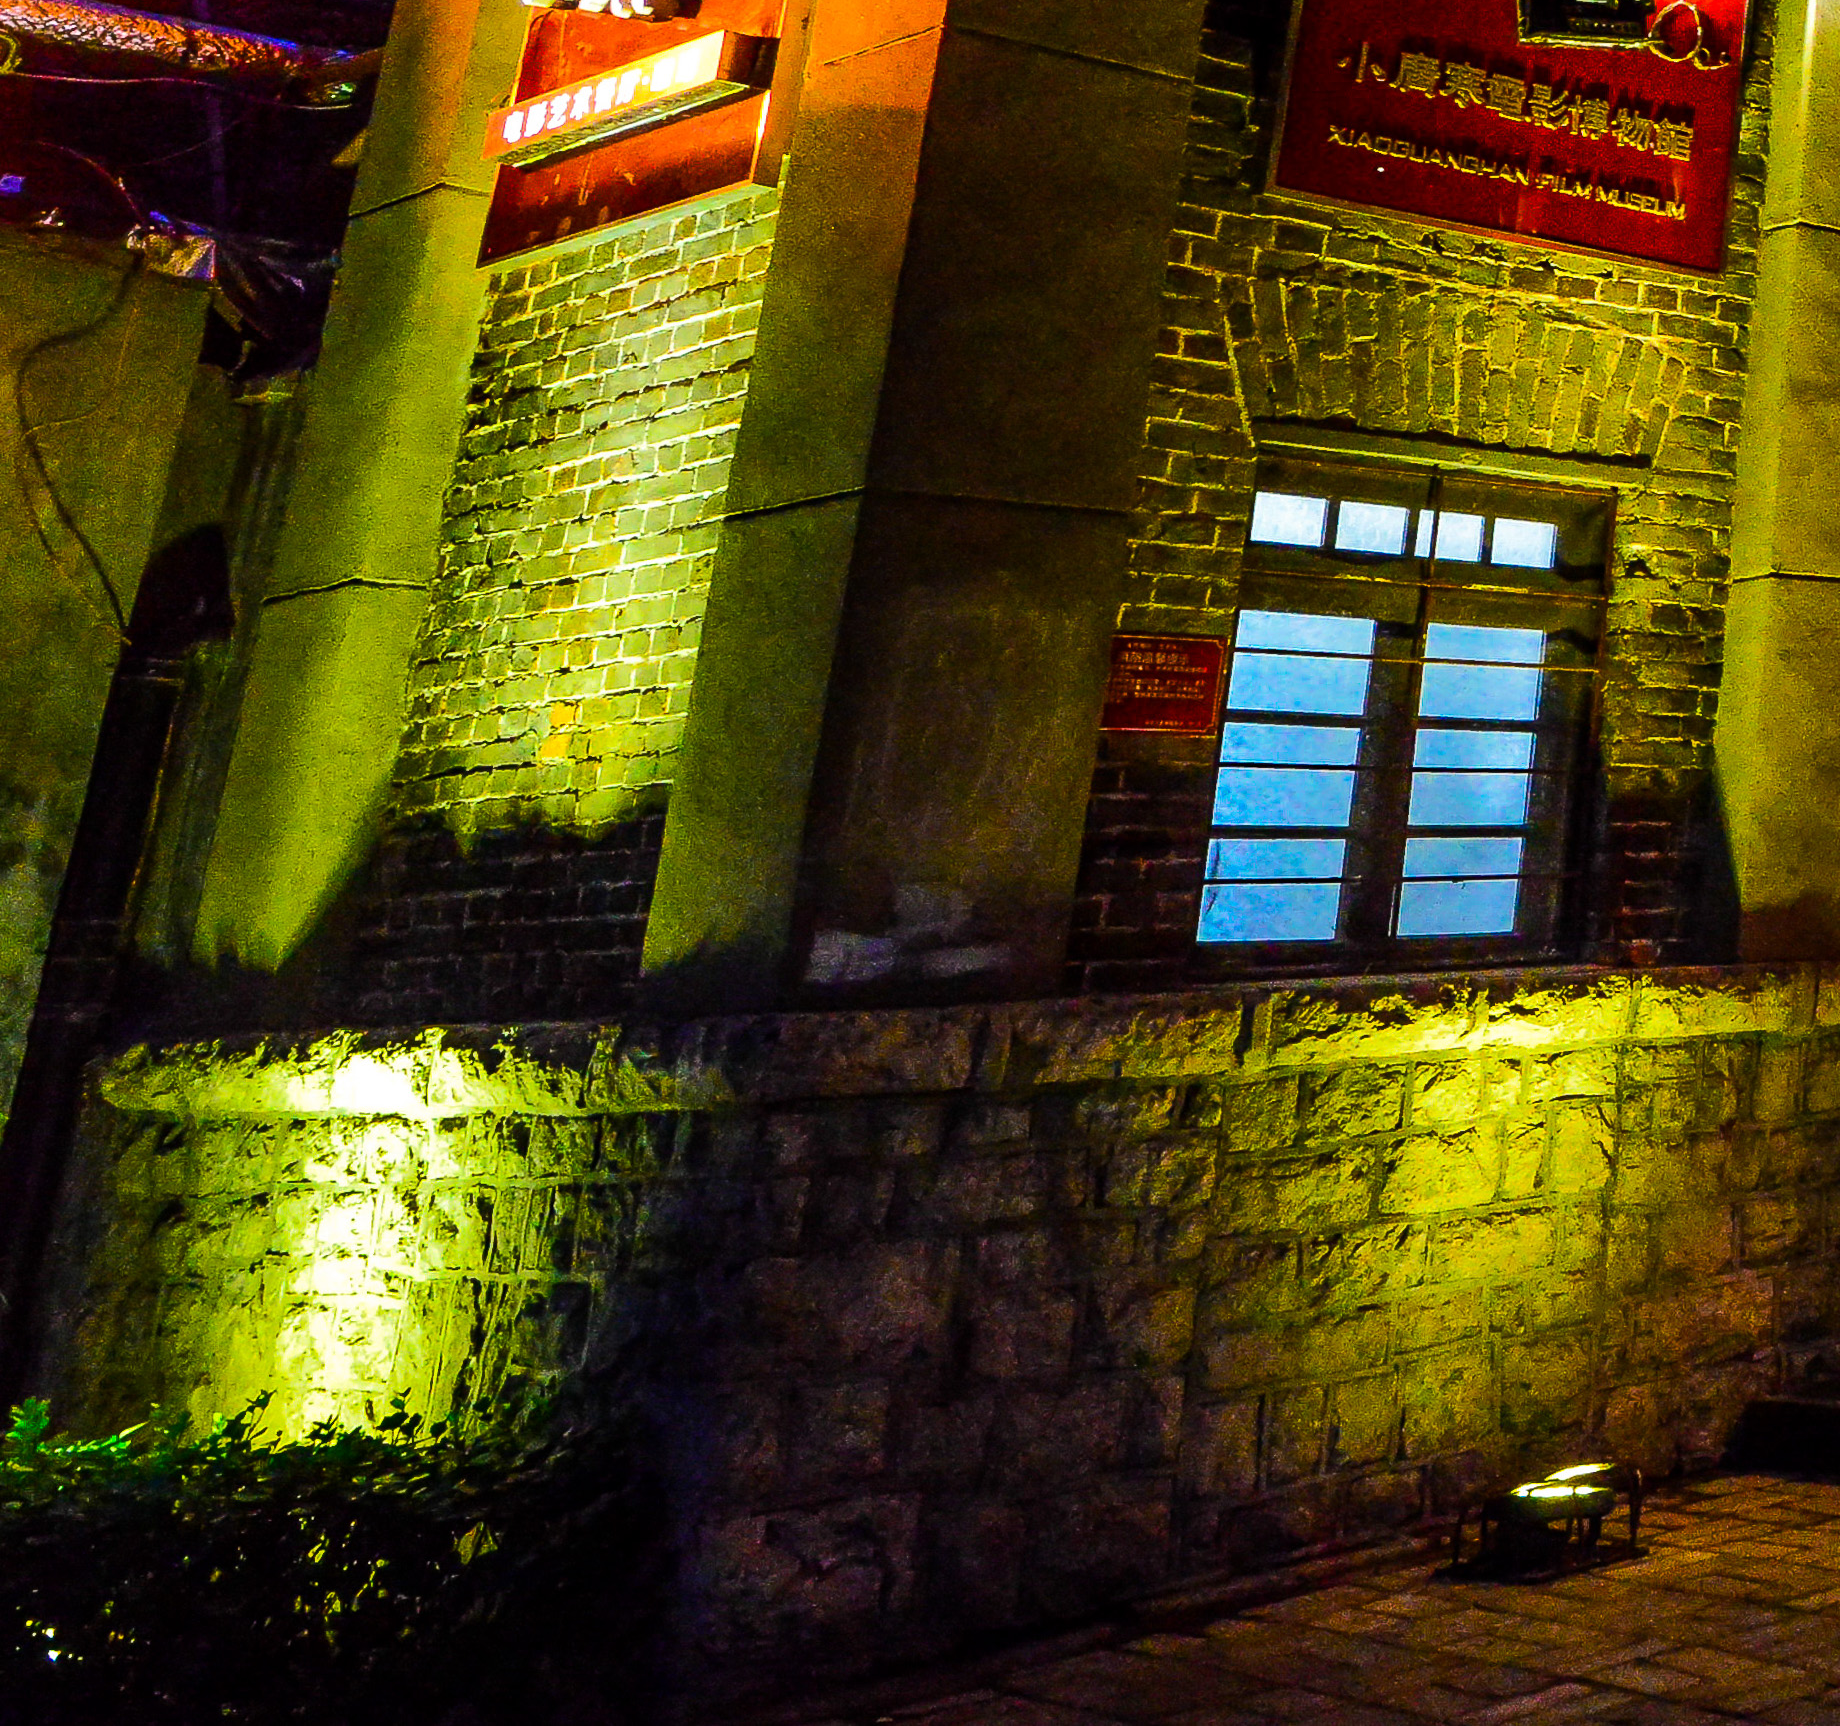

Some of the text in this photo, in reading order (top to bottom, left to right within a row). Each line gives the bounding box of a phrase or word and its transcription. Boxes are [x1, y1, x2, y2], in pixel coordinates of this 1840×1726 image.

[1327, 124, 1686, 221] XIAOGUANGHAN FILM MUSEUM
